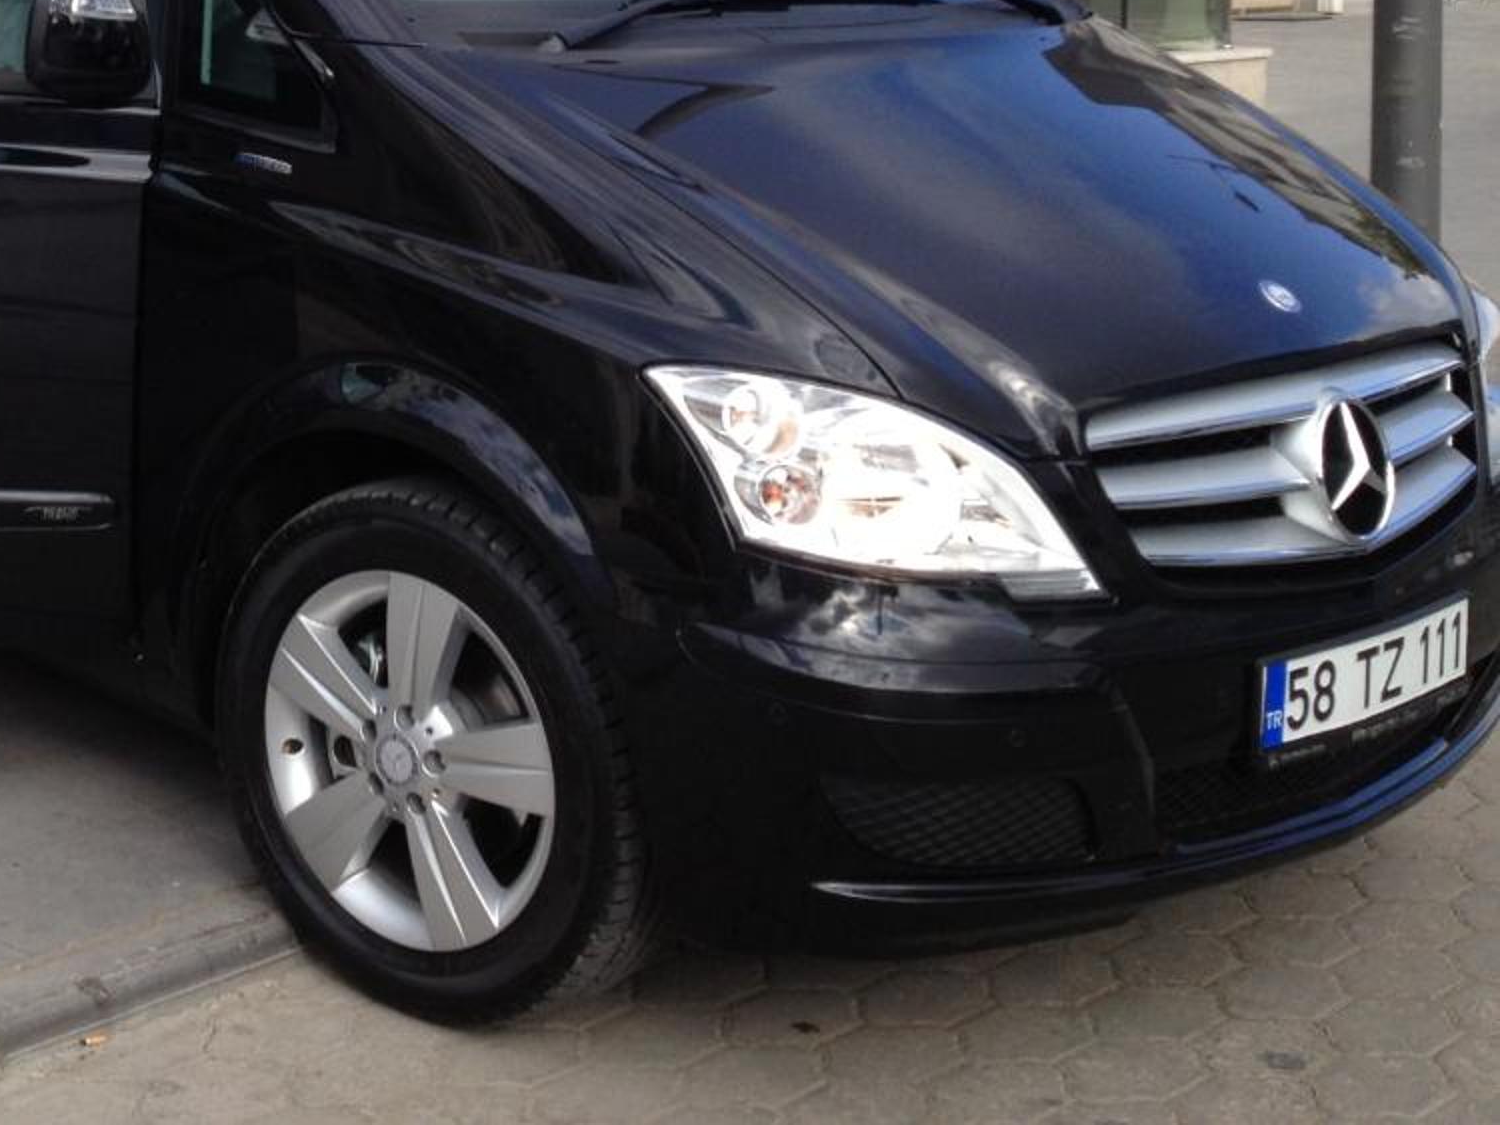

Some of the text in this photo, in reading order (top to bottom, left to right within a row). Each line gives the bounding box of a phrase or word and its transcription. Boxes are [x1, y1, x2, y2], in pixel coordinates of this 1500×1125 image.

[1286, 660, 1336, 730] 58
[1357, 636, 1405, 709] TZ
[1420, 611, 1461, 684] 111
[1266, 710, 1284, 730] TR
